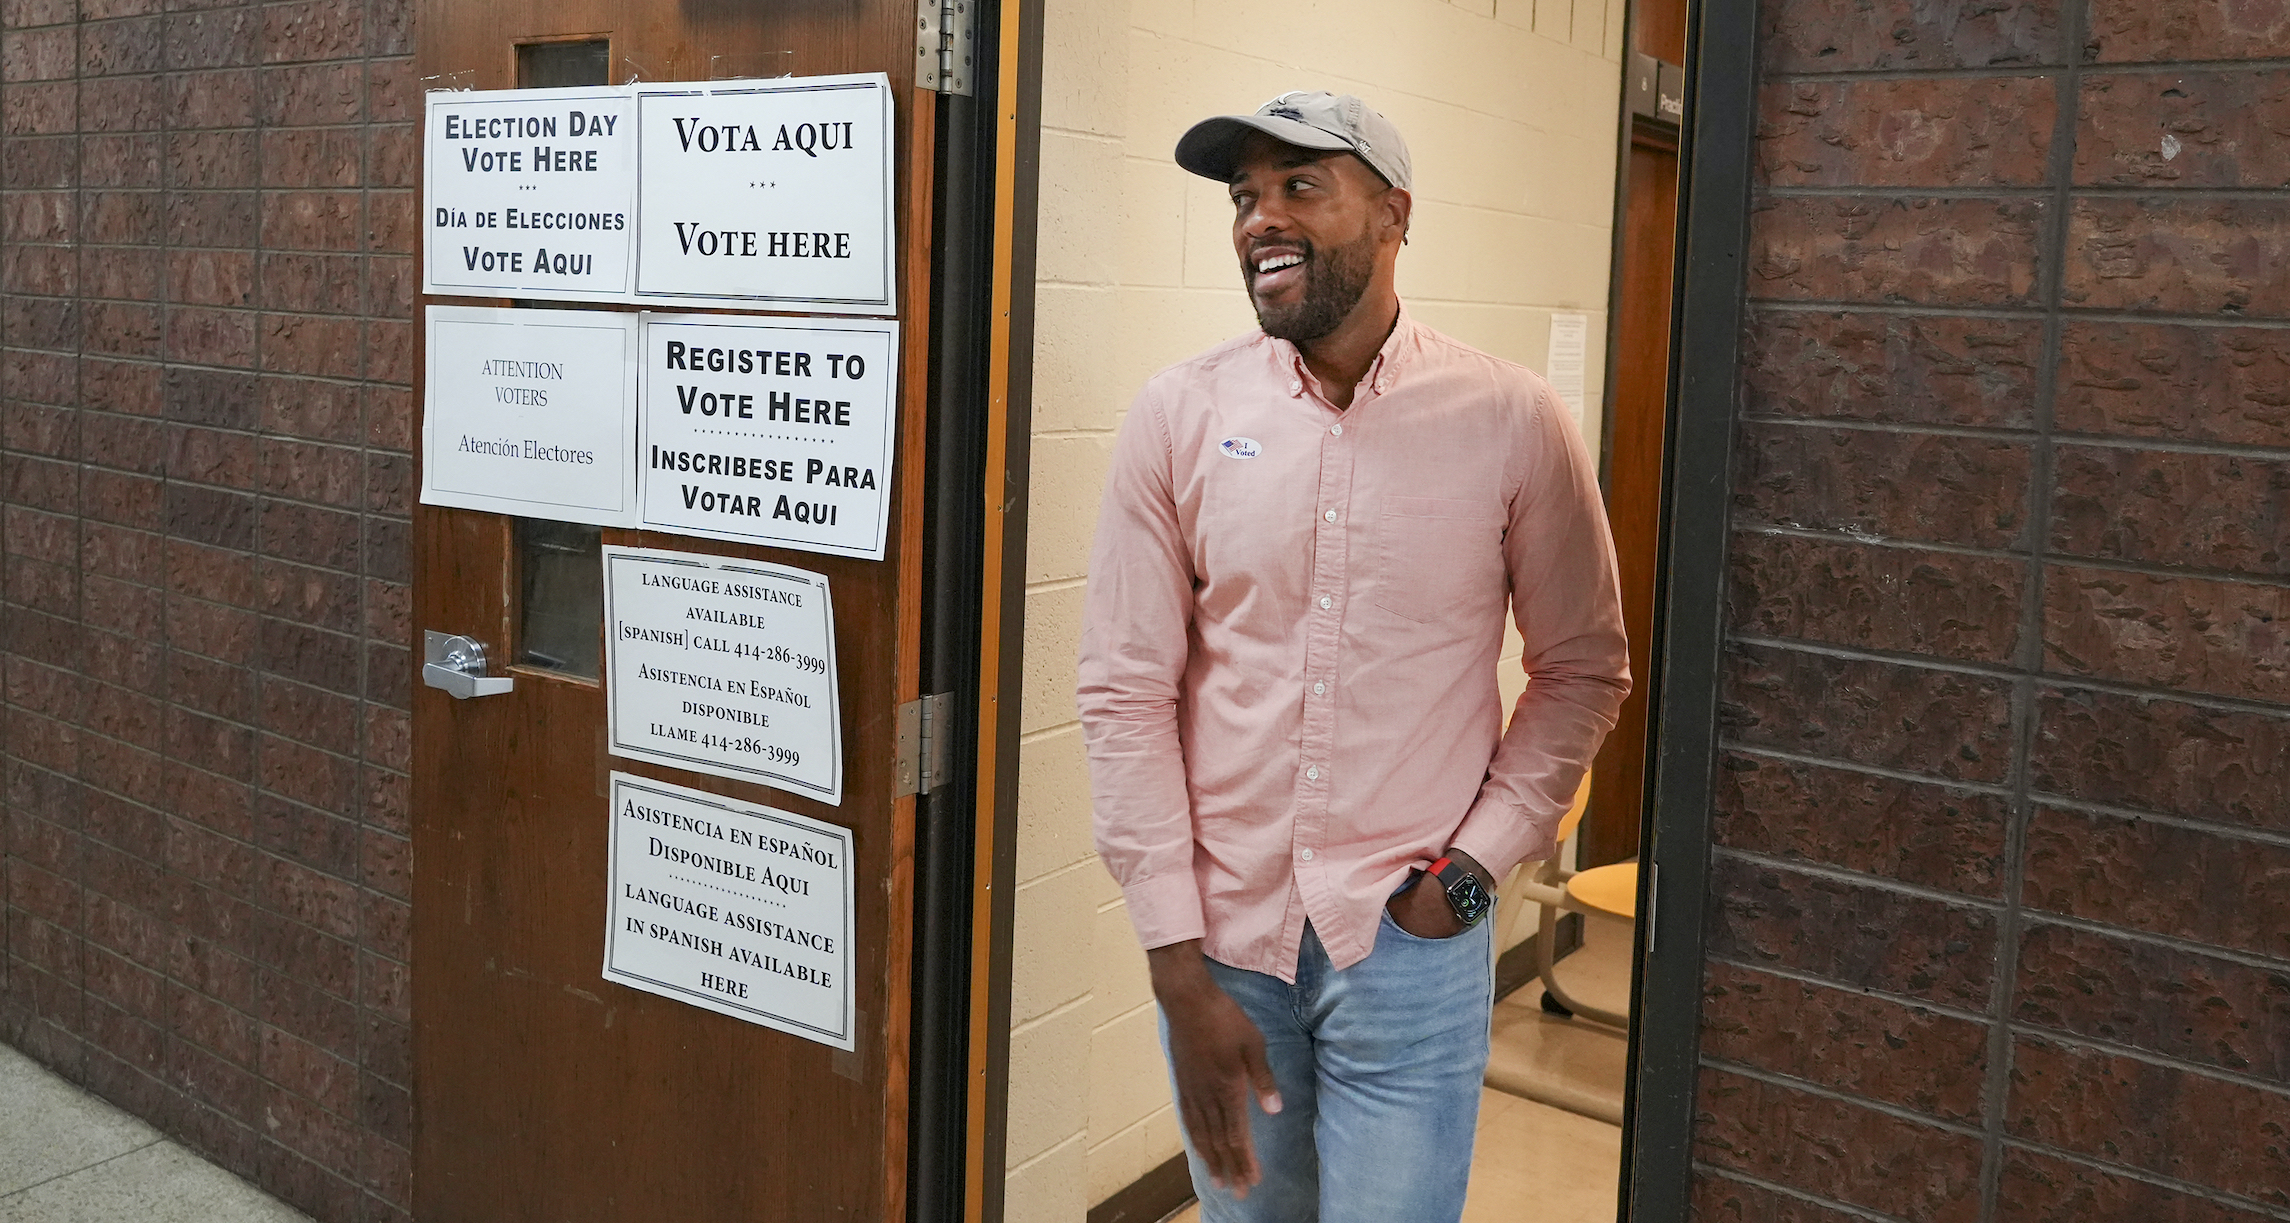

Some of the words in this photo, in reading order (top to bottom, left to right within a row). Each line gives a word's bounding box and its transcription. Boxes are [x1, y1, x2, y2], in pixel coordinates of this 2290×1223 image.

[446, 115, 556, 139] ELECTION
[570, 111, 617, 136] DAY
[673, 118, 761, 152] VOTA
[772, 122, 853, 157] AQUI
[462, 148, 521, 172] VOTE
[534, 147, 597, 171] HERE
[437, 208, 467, 227] DÍA
[476, 212, 496, 228] DE
[507, 209, 624, 230] ELECCIONES
[674, 223, 757, 256] VOTE
[768, 233, 850, 258] HERE
[463, 247, 522, 272] VOTE
[533, 249, 591, 275] AQUI
[482, 360, 563, 379] ATTENTION
[667, 341, 811, 377] REGISTER
[827, 354, 864, 380] TO
[495, 387, 547, 406] VOTERS
[677, 386, 752, 419] VOTE
[769, 391, 850, 426] HERE
[458, 434, 519, 457] Atención
[524, 440, 593, 464] Electores
[1235, 449, 1256, 457] Voted
[652, 445, 793, 482] INSCRIBESE
[807, 459, 875, 490] PARA
[682, 485, 760, 517] VOTAR
[772, 495, 836, 525] AQUI
[643, 574, 719, 594] LANGUAGE
[724, 584, 802, 607] ASSISTANCE
[686, 607, 764, 629] AVAILABLE
[620, 621, 688, 650] [SPANISH]
[694, 636, 729, 652] CALL
[734, 643, 825, 674] 414-286-3999
[638, 663, 722, 691] ASISTENCIA
[728, 681, 745, 694] EN
[751, 680, 810, 708] ESPAÑOL
[683, 701, 769, 727] DISPONIBLE
[651, 723, 697, 742] LLAME
[702, 734, 799, 766] 414-286-3999
[623, 799, 724, 840] ASISTENCIA
[730, 828, 752, 846] EN
[759, 835, 837, 869] ESPAÑOL
[650, 837, 755, 881] DISPONIBLE
[761, 867, 808, 896] AQUI
[626, 884, 718, 921] LANGUAGE
[724, 912, 834, 953] ASSISTANCE
[627, 917, 644, 934] IN
[650, 924, 722, 957] SPANISH
[729, 947, 831, 988] AVAILABLE
[701, 972, 748, 999] HERE
